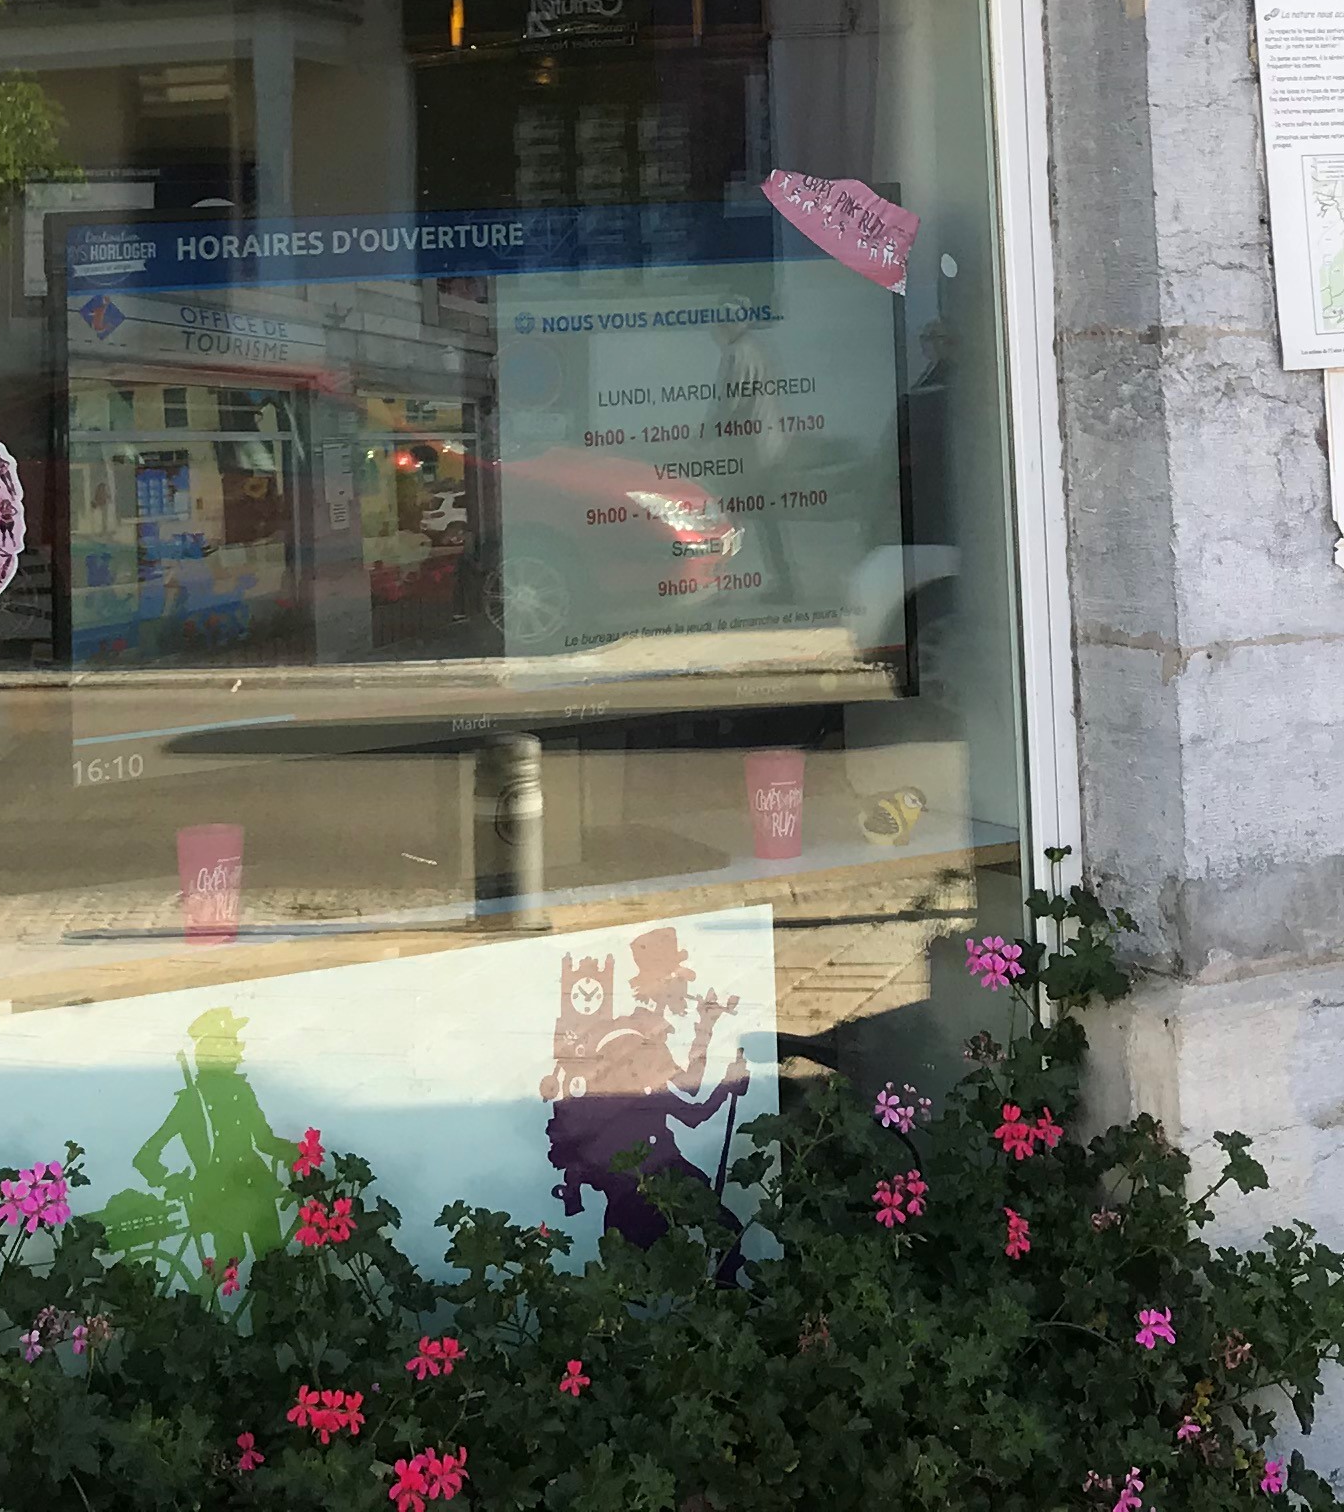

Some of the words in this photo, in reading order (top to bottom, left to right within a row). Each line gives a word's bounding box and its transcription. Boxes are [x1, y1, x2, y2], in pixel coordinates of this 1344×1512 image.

[89, 242, 157, 262] HORLOGER
[177, 232, 324, 261] HORAIRES
[332, 223, 524, 254] D'OUVERTURE
[181, 305, 256, 335] OFFICE
[262, 319, 289, 339] DE
[542, 315, 594, 333] NOUS
[598, 312, 648, 330] VOUS
[654, 305, 785, 327] ACCUEILLONS...
[181, 331, 289, 361] TOURISME
[598, 390, 656, 408] LUNDI,
[660, 384, 722, 403] MARDI,
[726, 377, 817, 398] MERCREDI
[584, 430, 625, 447] 9h00
[641, 425, 690, 444] 12h00
[715, 420, 762, 438] 14h00
[778, 414, 825, 433] 17h30
[655, 457, 744, 480] VENDREDI
[586, 507, 627, 525] 9h00
[717, 495, 765, 513] 14h00
[779, 490, 828, 508] 17h00
[658, 579, 697, 597] 9h00
[715, 571, 762, 591] 12h00
[565, 635, 578, 647] Le
[581, 631, 619, 646] bureau
[729, 614, 780, 630] dimanche
[452, 713, 491, 733] Mardi
[72, 752, 145, 785] 16:10
